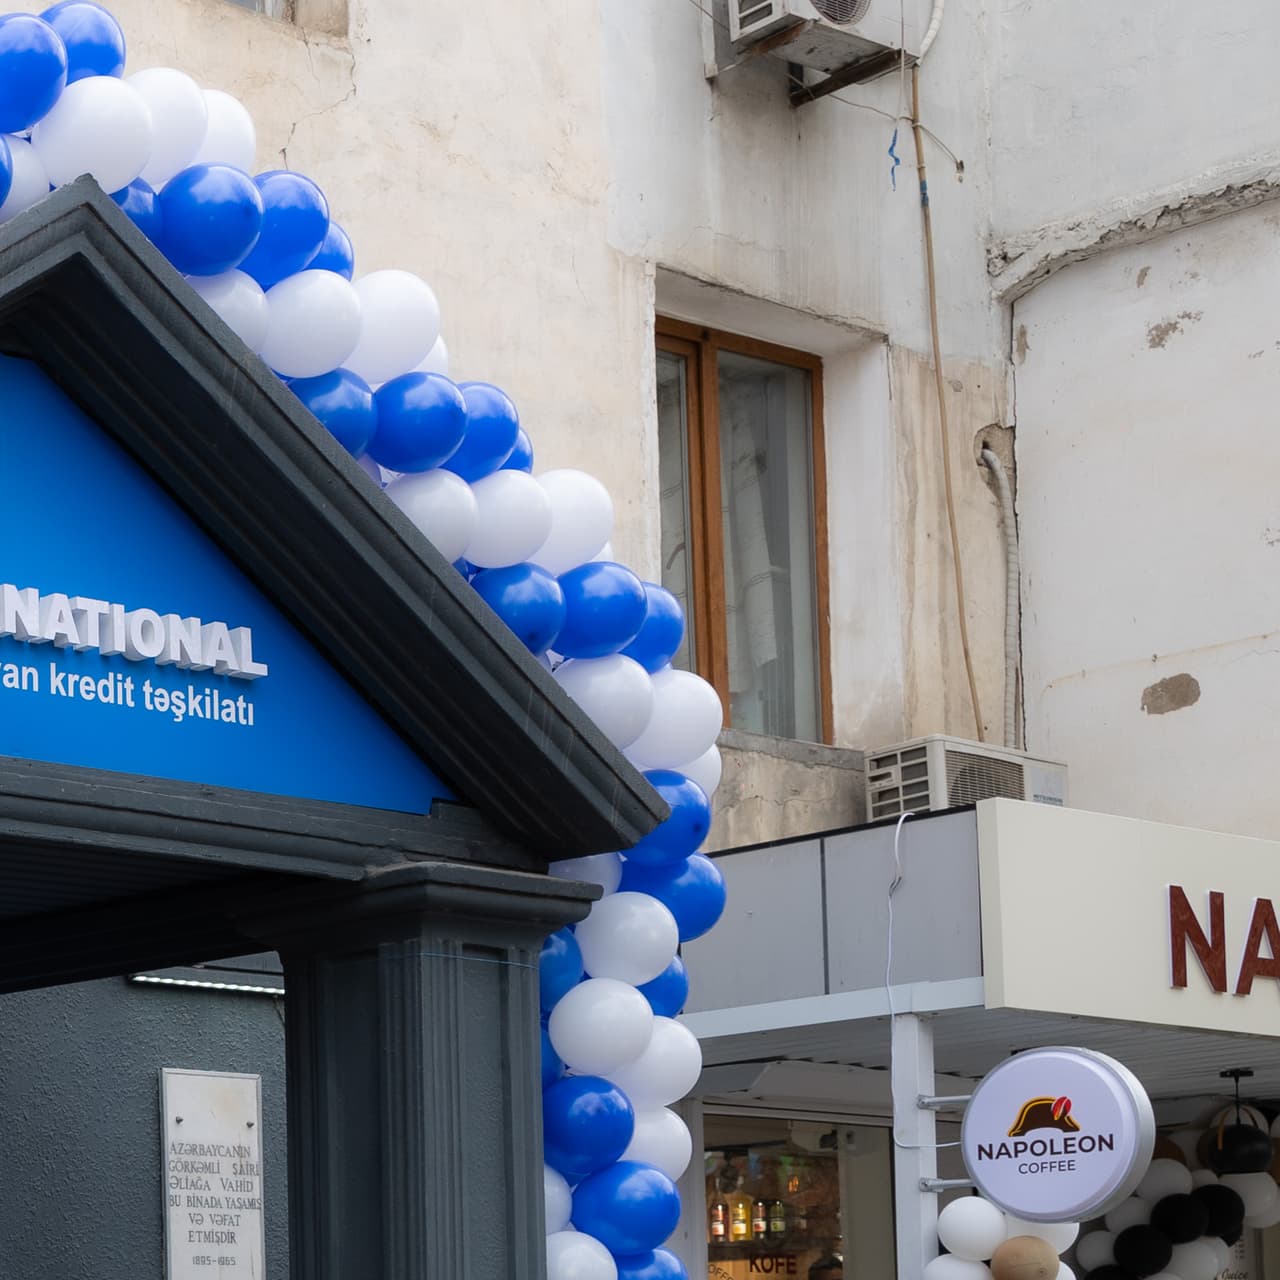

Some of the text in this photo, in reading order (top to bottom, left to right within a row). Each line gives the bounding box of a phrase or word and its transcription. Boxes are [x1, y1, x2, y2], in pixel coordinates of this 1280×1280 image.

[50, 662, 135, 708] kredit
[143, 679, 254, 726] təşkilatı
[977, 1133, 1114, 1161] NAPOLEON
[168, 1158, 220, 1174] GÖRKƏMLİ
[1018, 1160, 1076, 1175] COFFEE
[169, 1195, 181, 1207] BU
[186, 1193, 222, 1208] BİNADA
[188, 1213, 240, 1226] VƏ VƏFAT
[749, 1255, 797, 1274] KOFE
